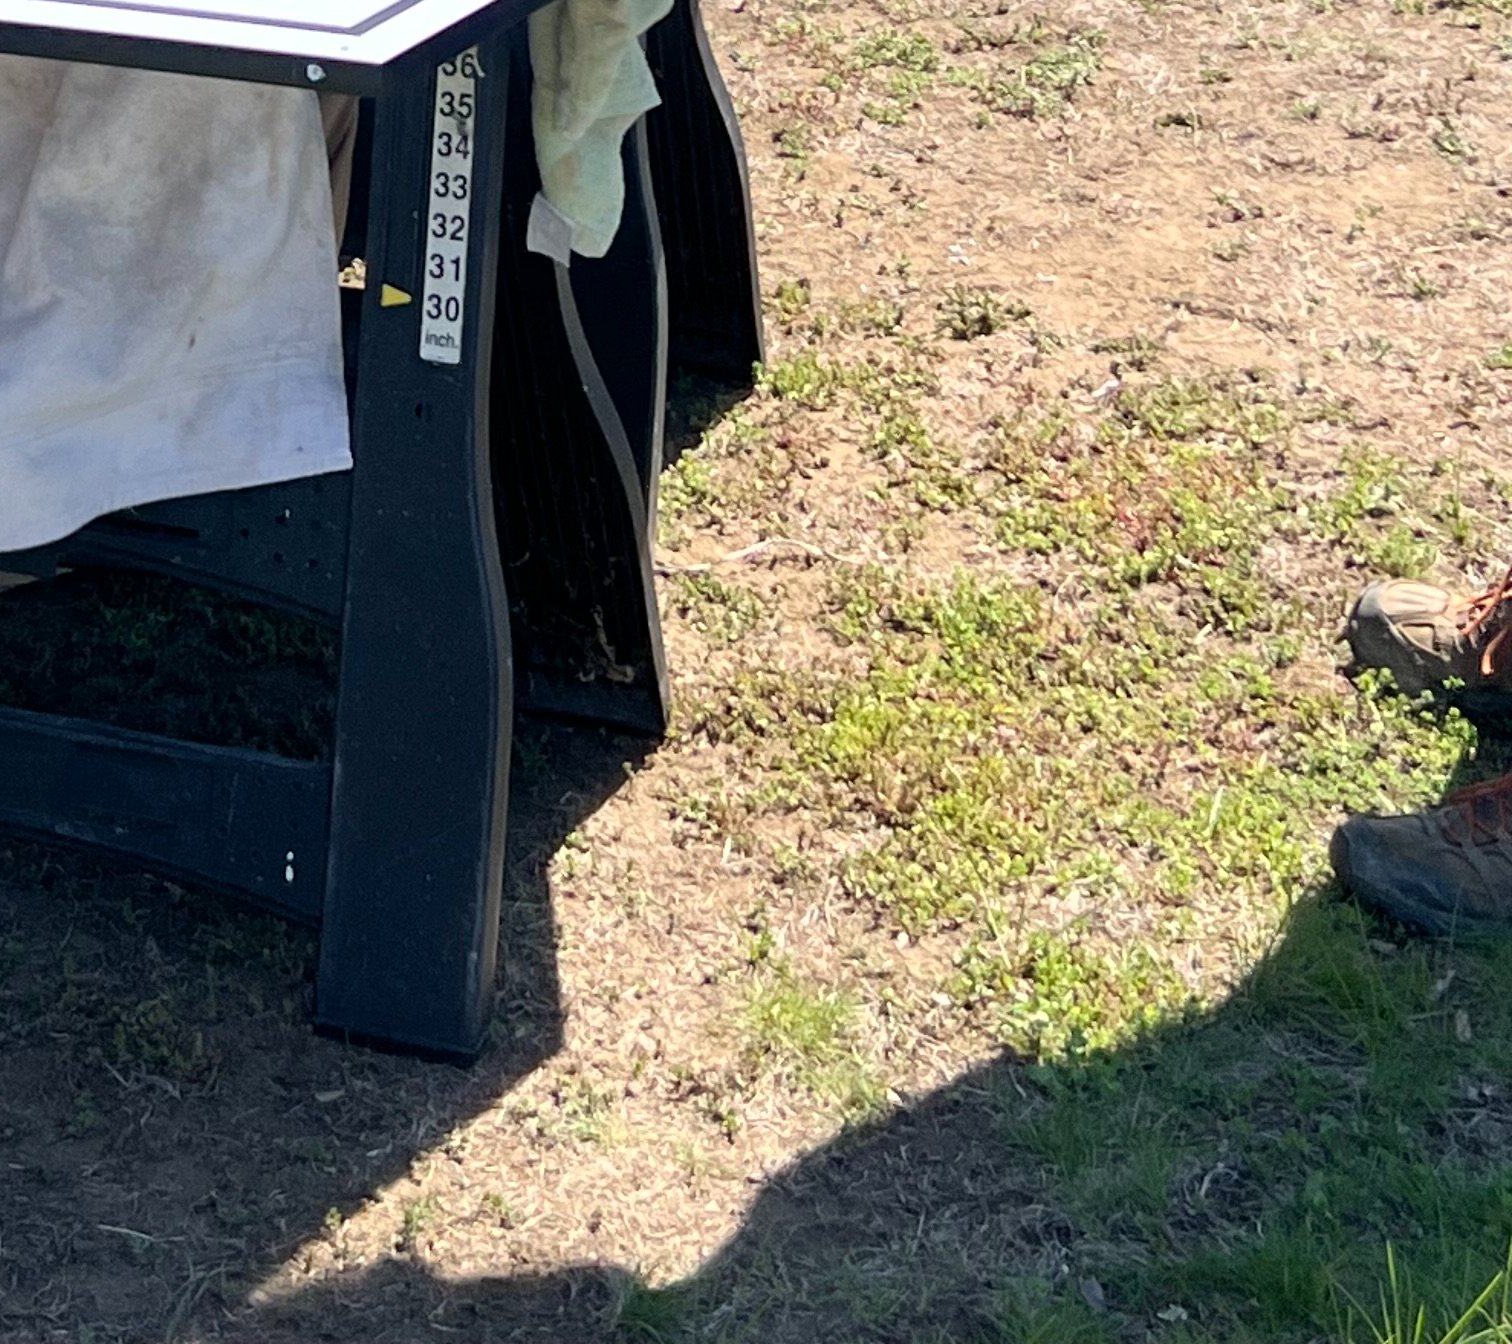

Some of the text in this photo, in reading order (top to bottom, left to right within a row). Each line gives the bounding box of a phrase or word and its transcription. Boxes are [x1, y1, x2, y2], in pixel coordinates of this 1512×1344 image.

[439, 91, 473, 119] 35
[437, 132, 470, 160] 34
[434, 171, 468, 200] 33
[431, 212, 465, 242] 32
[428, 253, 461, 282] 31
[426, 293, 460, 322] 30
